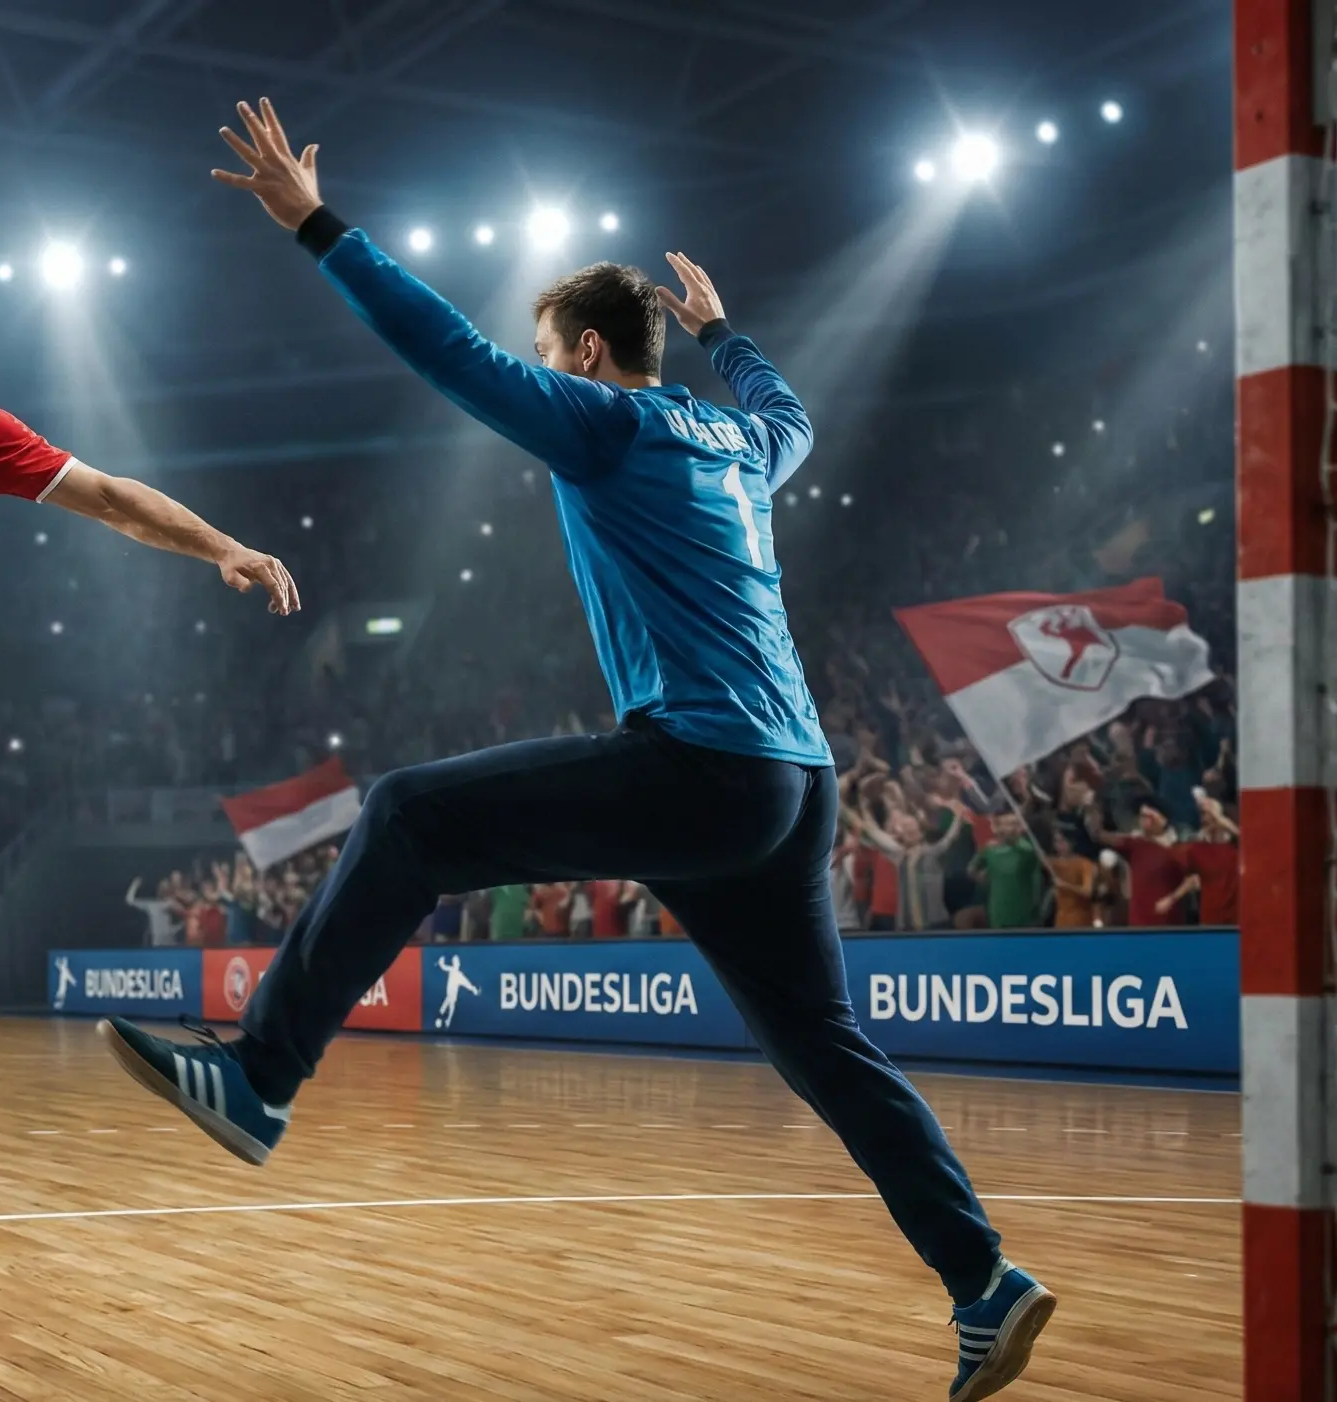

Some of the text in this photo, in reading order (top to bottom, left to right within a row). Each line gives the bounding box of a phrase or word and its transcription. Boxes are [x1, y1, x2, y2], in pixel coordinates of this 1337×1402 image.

[722, 461, 763, 568] 1
[84, 968, 183, 999] BUNDESLIGA
[499, 972, 698, 1015] BUNDESLIGA
[869, 973, 1189, 1030] BUNDESLIGA
